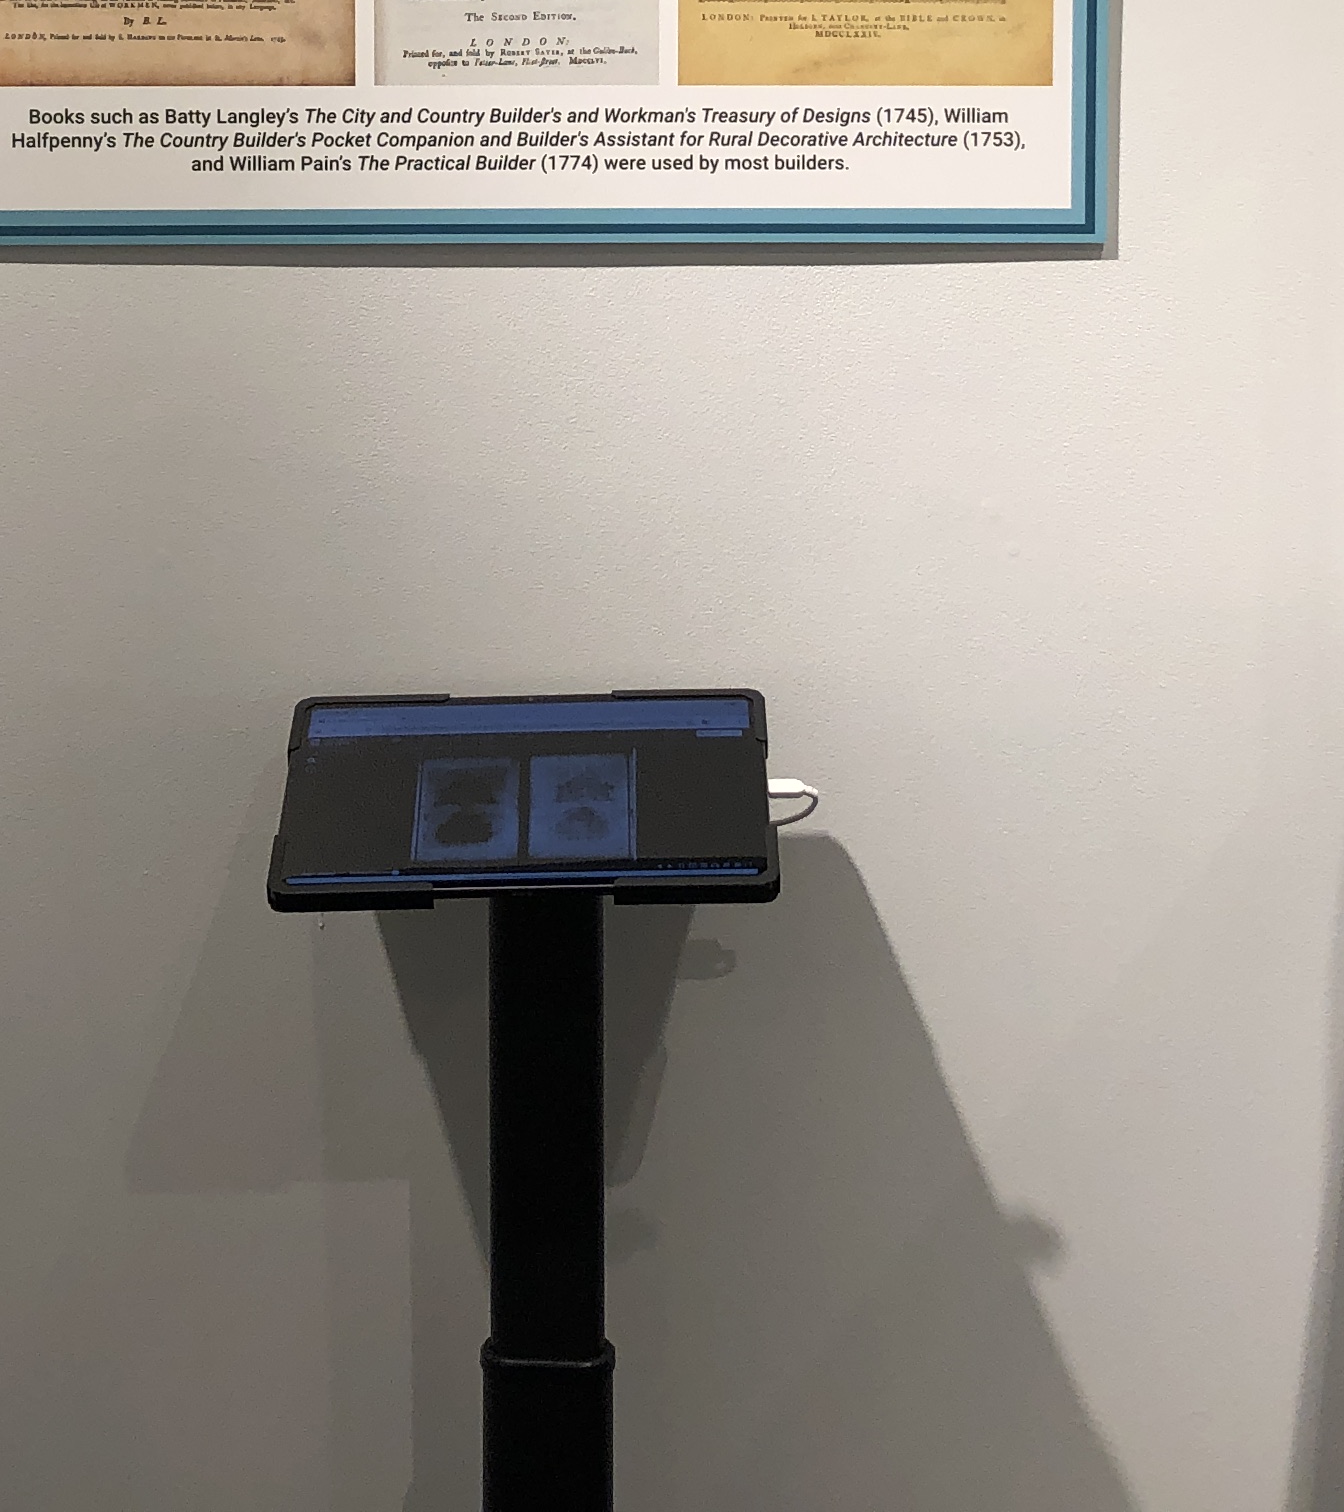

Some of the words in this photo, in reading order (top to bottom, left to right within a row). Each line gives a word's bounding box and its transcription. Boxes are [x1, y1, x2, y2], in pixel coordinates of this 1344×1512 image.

[29, 107, 85, 124] Books
[90, 107, 133, 124] such
[138, 112, 159, 124] as
[165, 108, 211, 128] Batty
[216, 107, 299, 128] Langley's
[304, 107, 337, 124] The
[341, 107, 376, 128] City
[379, 107, 413, 124] and
[417, 107, 485, 127] Country
[489, 106, 562, 123] Builder's
[566, 106, 599, 123] and
[604, 106, 696, 123] Workman's
[701, 107, 776, 127] Treasury
[780, 106, 799, 124] of
[802, 106, 871, 127] Designs
[876, 106, 938, 127] (1745),
[943, 107, 1008, 123] William
[11, 131, 116, 152] Halfpenny's
[122, 131, 154, 148] The
[159, 132, 229, 152] Country
[232, 131, 306, 148] Builder's
[311, 130, 372, 147] Pocket
[376, 131, 474, 151] Companion
[479, 130, 512, 147] and
[516, 130, 589, 147] Builder's
[592, 130, 675, 147] Assistant
[679, 130, 705, 147] for
[708, 130, 753, 147] Rural
[757, 130, 848, 147] Decorative
[851, 130, 958, 147] Architecture
[963, 130, 1025, 151] (1753),
[191, 155, 224, 171] and
[229, 154, 295, 171] William
[301, 154, 351, 171] Pain's
[357, 154, 390, 171] The
[394, 154, 471, 171] Practical
[475, 154, 537, 171] Builder
[541, 153, 598, 174] (1774)
[603, 158, 646, 170] were
[651, 154, 693, 170] used
[699, 154, 719, 174] by
[724, 155, 769, 170] most
[774, 154, 849, 170] builders.
